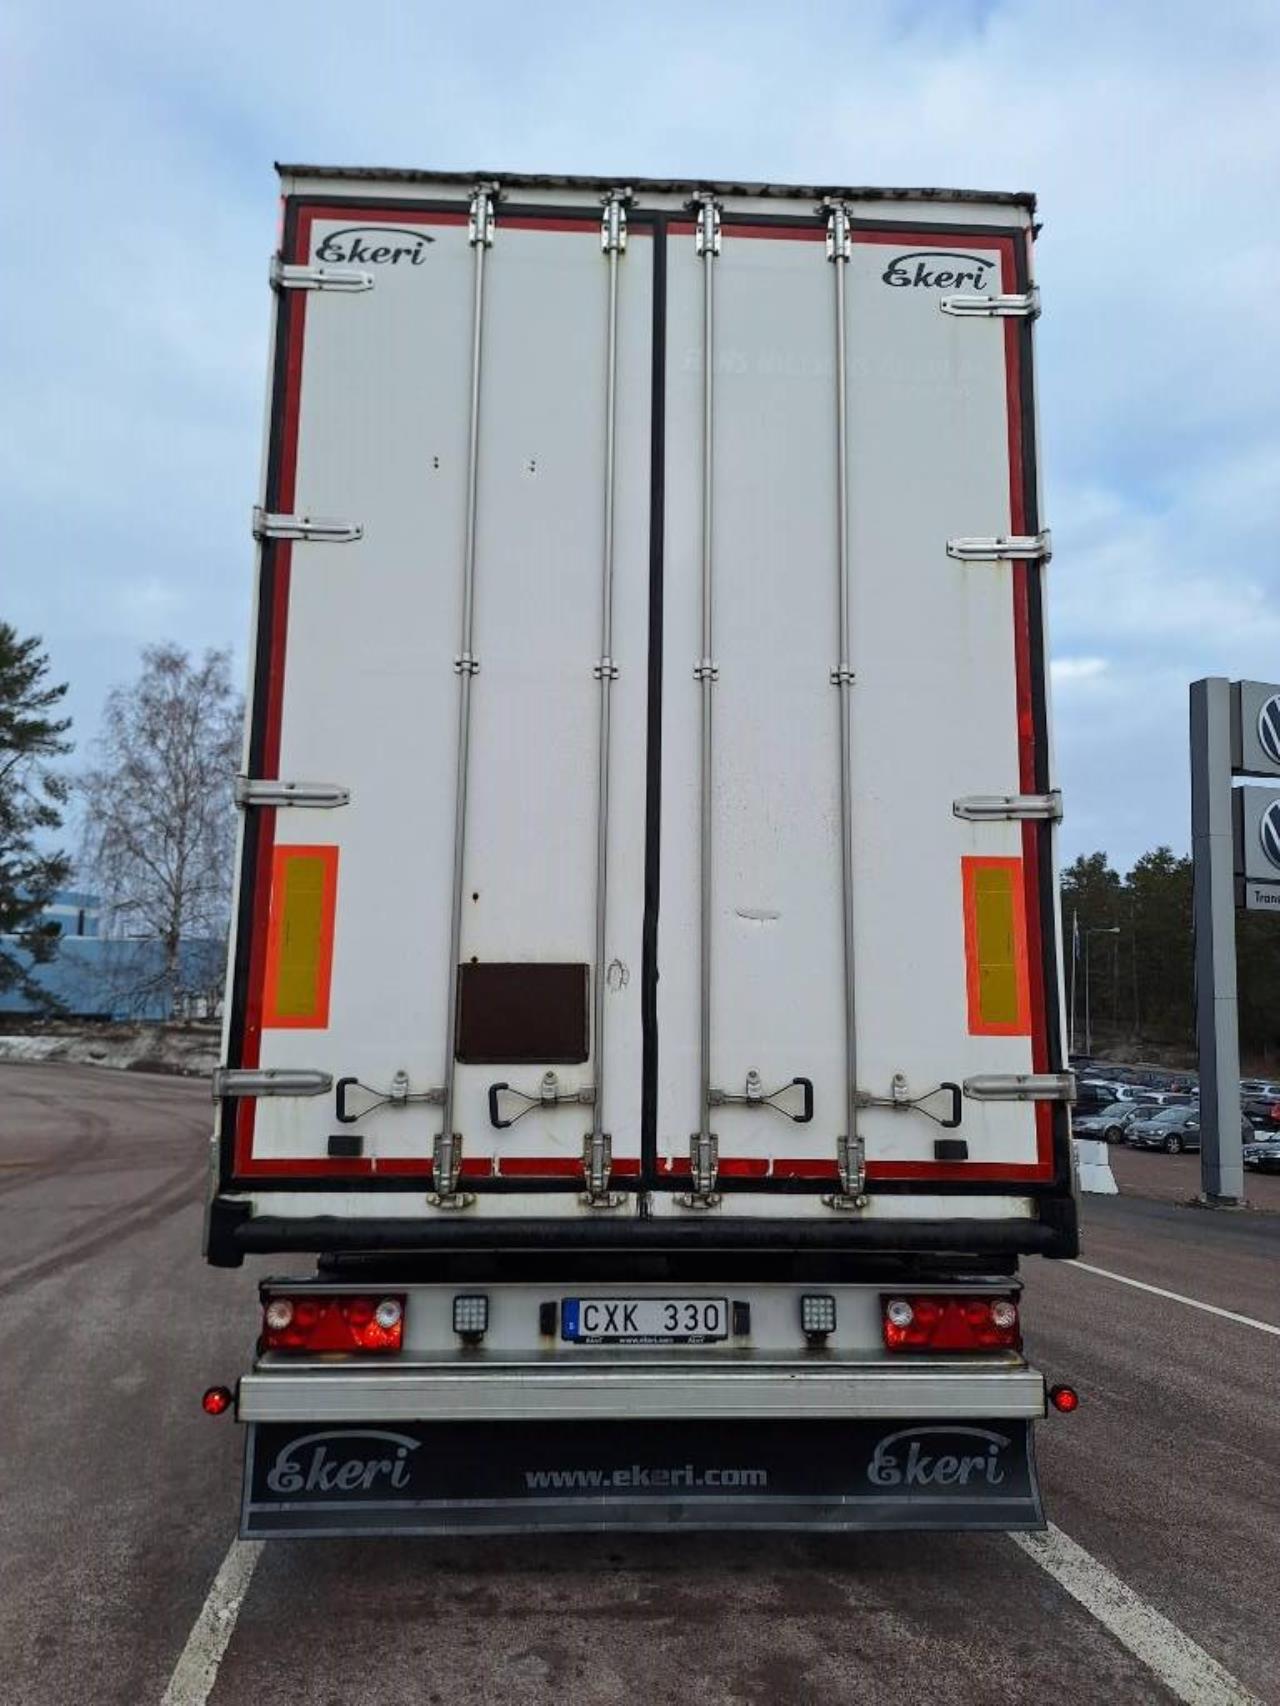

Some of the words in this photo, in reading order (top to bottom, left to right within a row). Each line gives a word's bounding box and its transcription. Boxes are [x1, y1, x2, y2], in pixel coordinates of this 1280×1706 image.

[315, 227, 436, 265] Ekeri
[882, 252, 996, 290] Ekeri
[584, 1304, 639, 1332] CXK
[664, 1304, 719, 1332] 330
[267, 1430, 422, 1492] Ekeri
[867, 1426, 1011, 1486] Ekeri
[526, 1464, 767, 1489] www.ekeri.com
